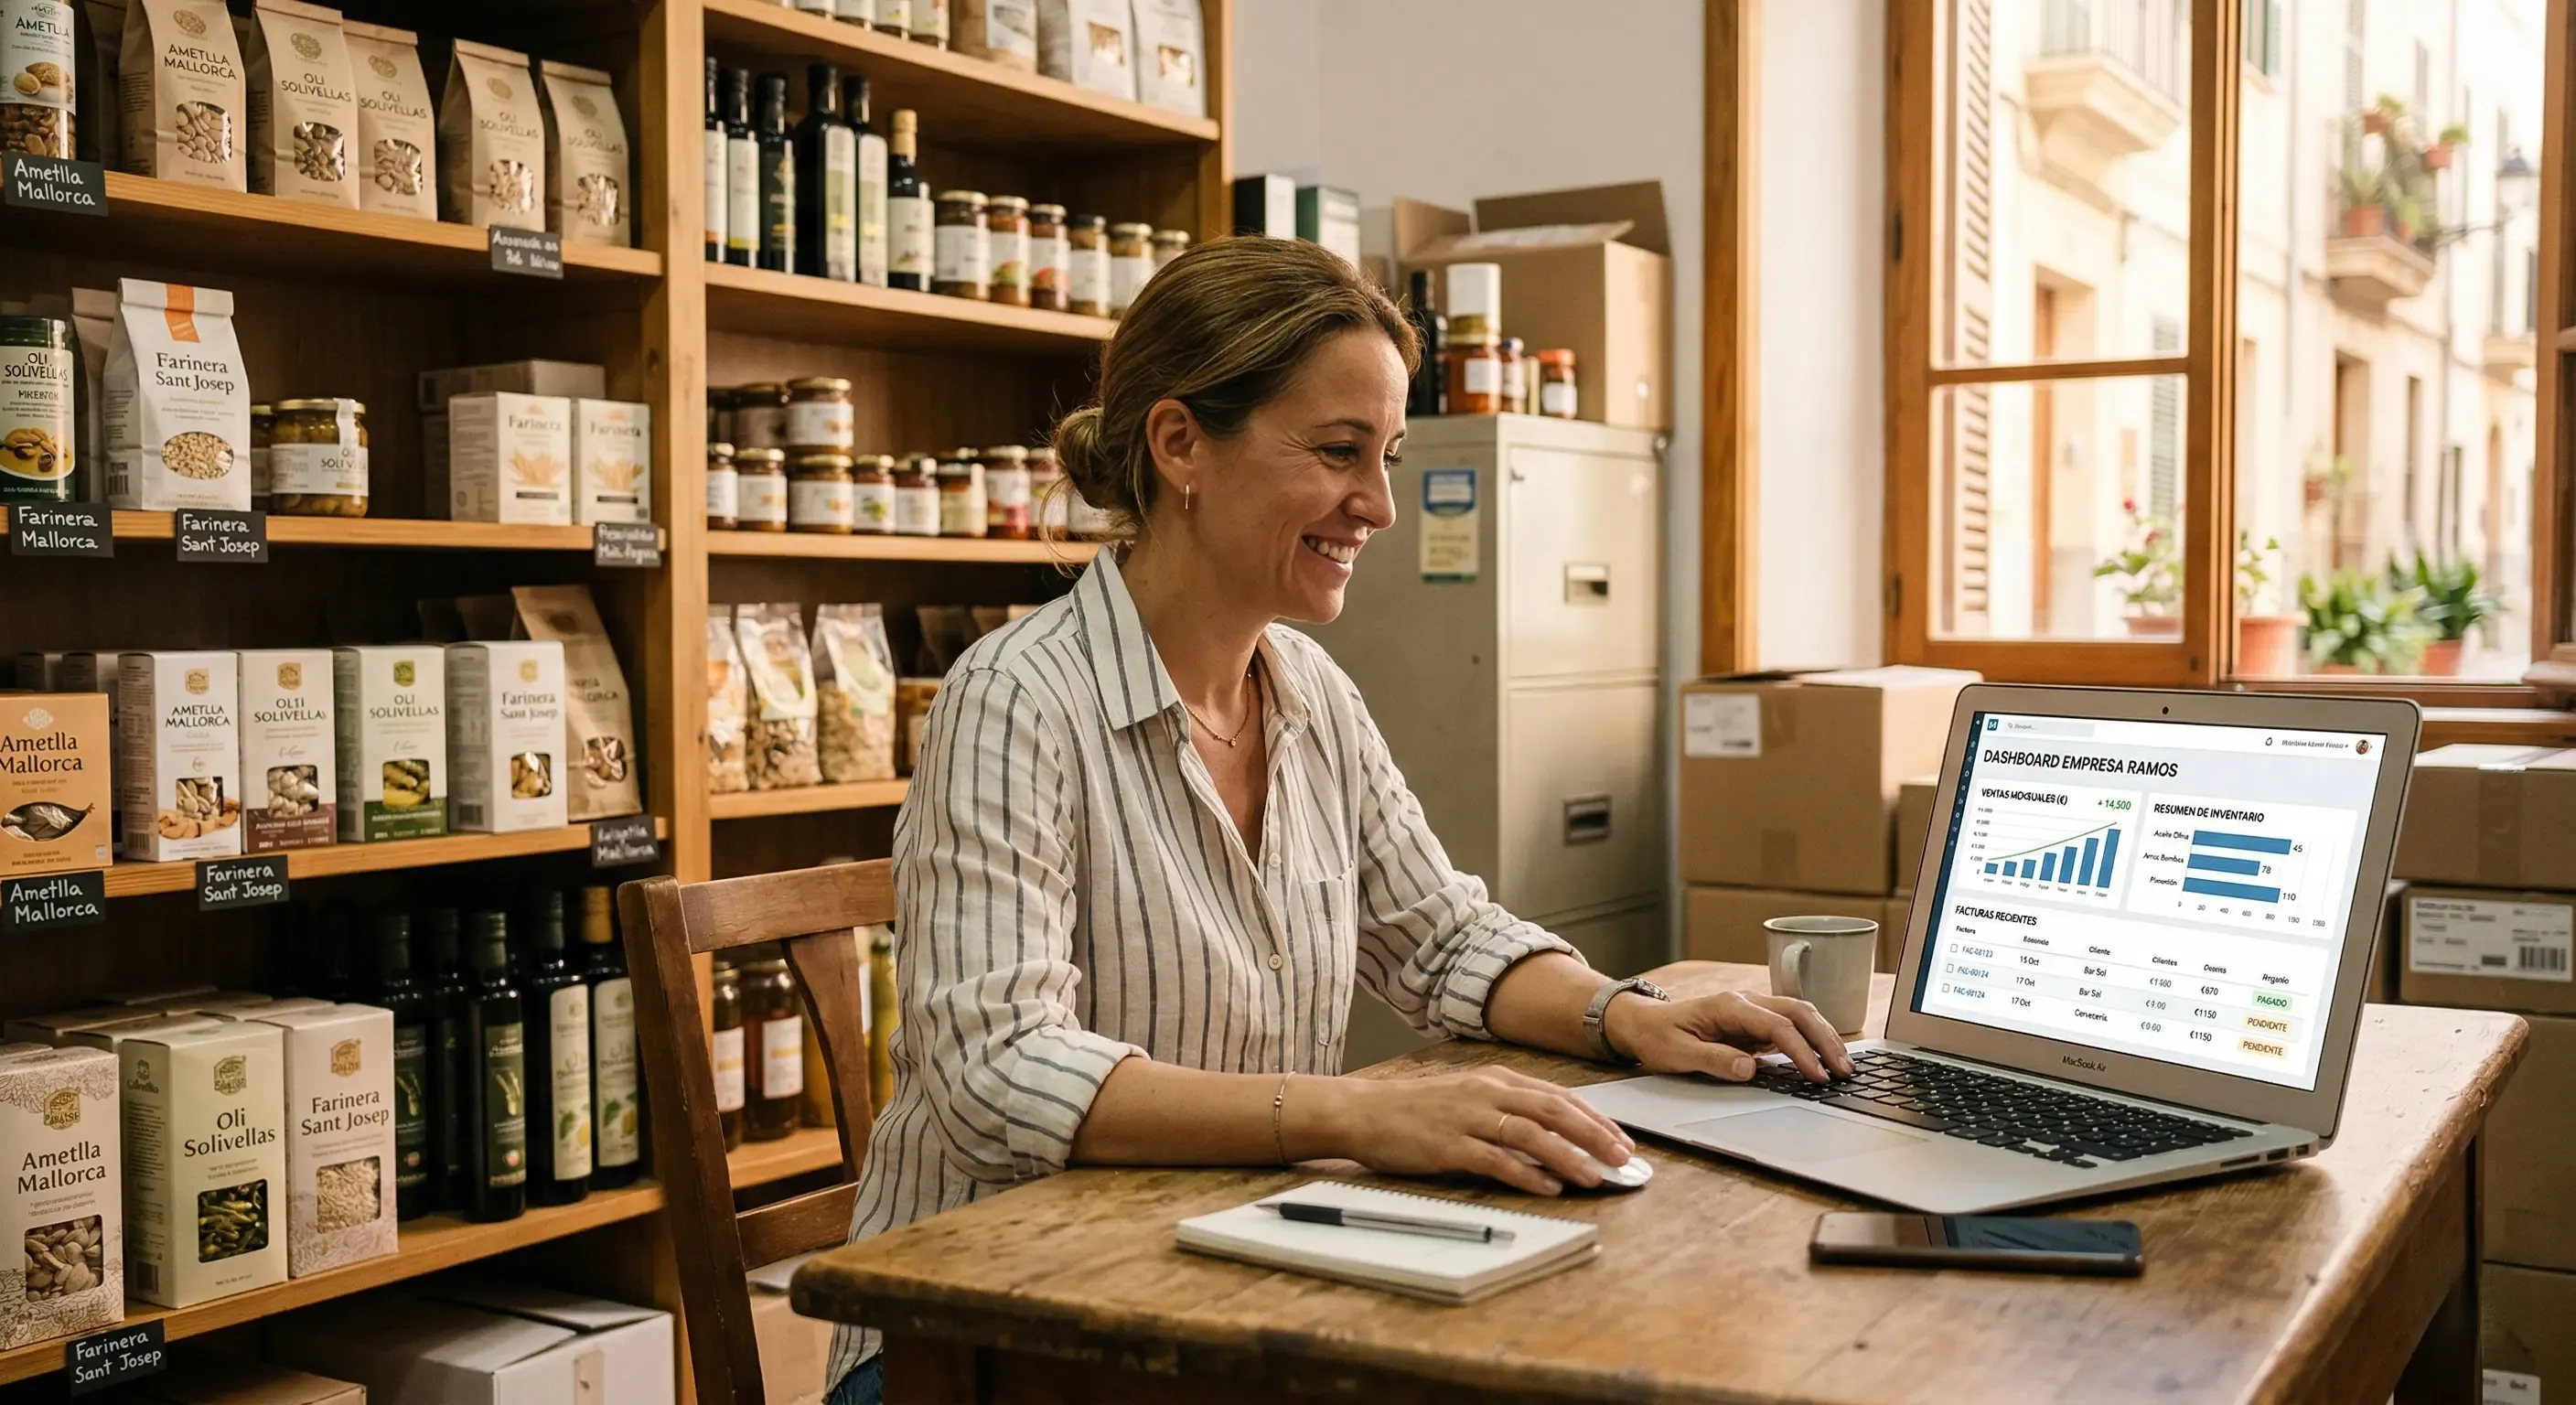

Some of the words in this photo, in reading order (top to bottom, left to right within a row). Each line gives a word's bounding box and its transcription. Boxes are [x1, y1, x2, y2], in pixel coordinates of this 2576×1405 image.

[168, 44, 231, 66] AMETLLA
[164, 56, 237, 80] MALLORCA
[304, 72, 325, 86] OLI
[281, 80, 352, 102] SOLIVELLAS
[381, 91, 401, 102] OLI
[14, 159, 84, 185] Ametlla
[18, 182, 95, 207] Mallorca
[156, 352, 229, 374] Farinera
[156, 370, 190, 388] Sant
[193, 375, 234, 395] Josep
[18, 507, 98, 528] Farinera
[182, 513, 250, 534] Farinera
[22, 531, 99, 550] Mallorca
[182, 536, 215, 552] Sant
[220, 536, 260, 557] Josep
[172, 704, 224, 715] AMETLLA
[395, 694, 415, 705] OLI
[166, 716, 231, 728] MALLORCA
[370, 705, 439, 719] SOLIVELLAS
[0, 732, 79, 754] Ametlla
[0, 755, 83, 775] Mallorca
[1983, 749, 2060, 769] DASHBOARD
[2062, 755, 2123, 774] EMPRESA
[2127, 761, 2179, 778] RAMOS
[2105, 799, 2131, 811] 14,500
[2154, 803, 2195, 816] RESUMEN
[2196, 807, 2209, 817] DE
[2210, 809, 2265, 823] INVENTARIO
[2293, 844, 2303, 853] 45
[207, 864, 274, 884] Farinera
[2261, 865, 2271, 874] 78
[10, 879, 82, 904] Ametlla
[204, 885, 237, 904] Sant
[242, 880, 283, 903] Josep
[2283, 892, 2296, 901] 110
[16, 902, 99, 924] Mallorca
[1955, 906, 1994, 919] FACTURAS
[1995, 911, 2037, 926] RECIENTES
[2084, 966, 2096, 975] Bar
[2097, 968, 2107, 977] Sol
[2257, 995, 2287, 1007] PAGADO
[312, 1090, 381, 1115] Farinera
[216, 1108, 246, 1132] Oli
[301, 1118, 342, 1137] Sant
[346, 1108, 390, 1132] Josep
[184, 1127, 276, 1158] Solivellas
[22, 1141, 102, 1173] Ametlla
[17, 1166, 106, 1195] Mallorca
[75, 1330, 148, 1361] Farinera
[75, 1360, 112, 1385] Sant
[119, 1349, 162, 1376] Josep
